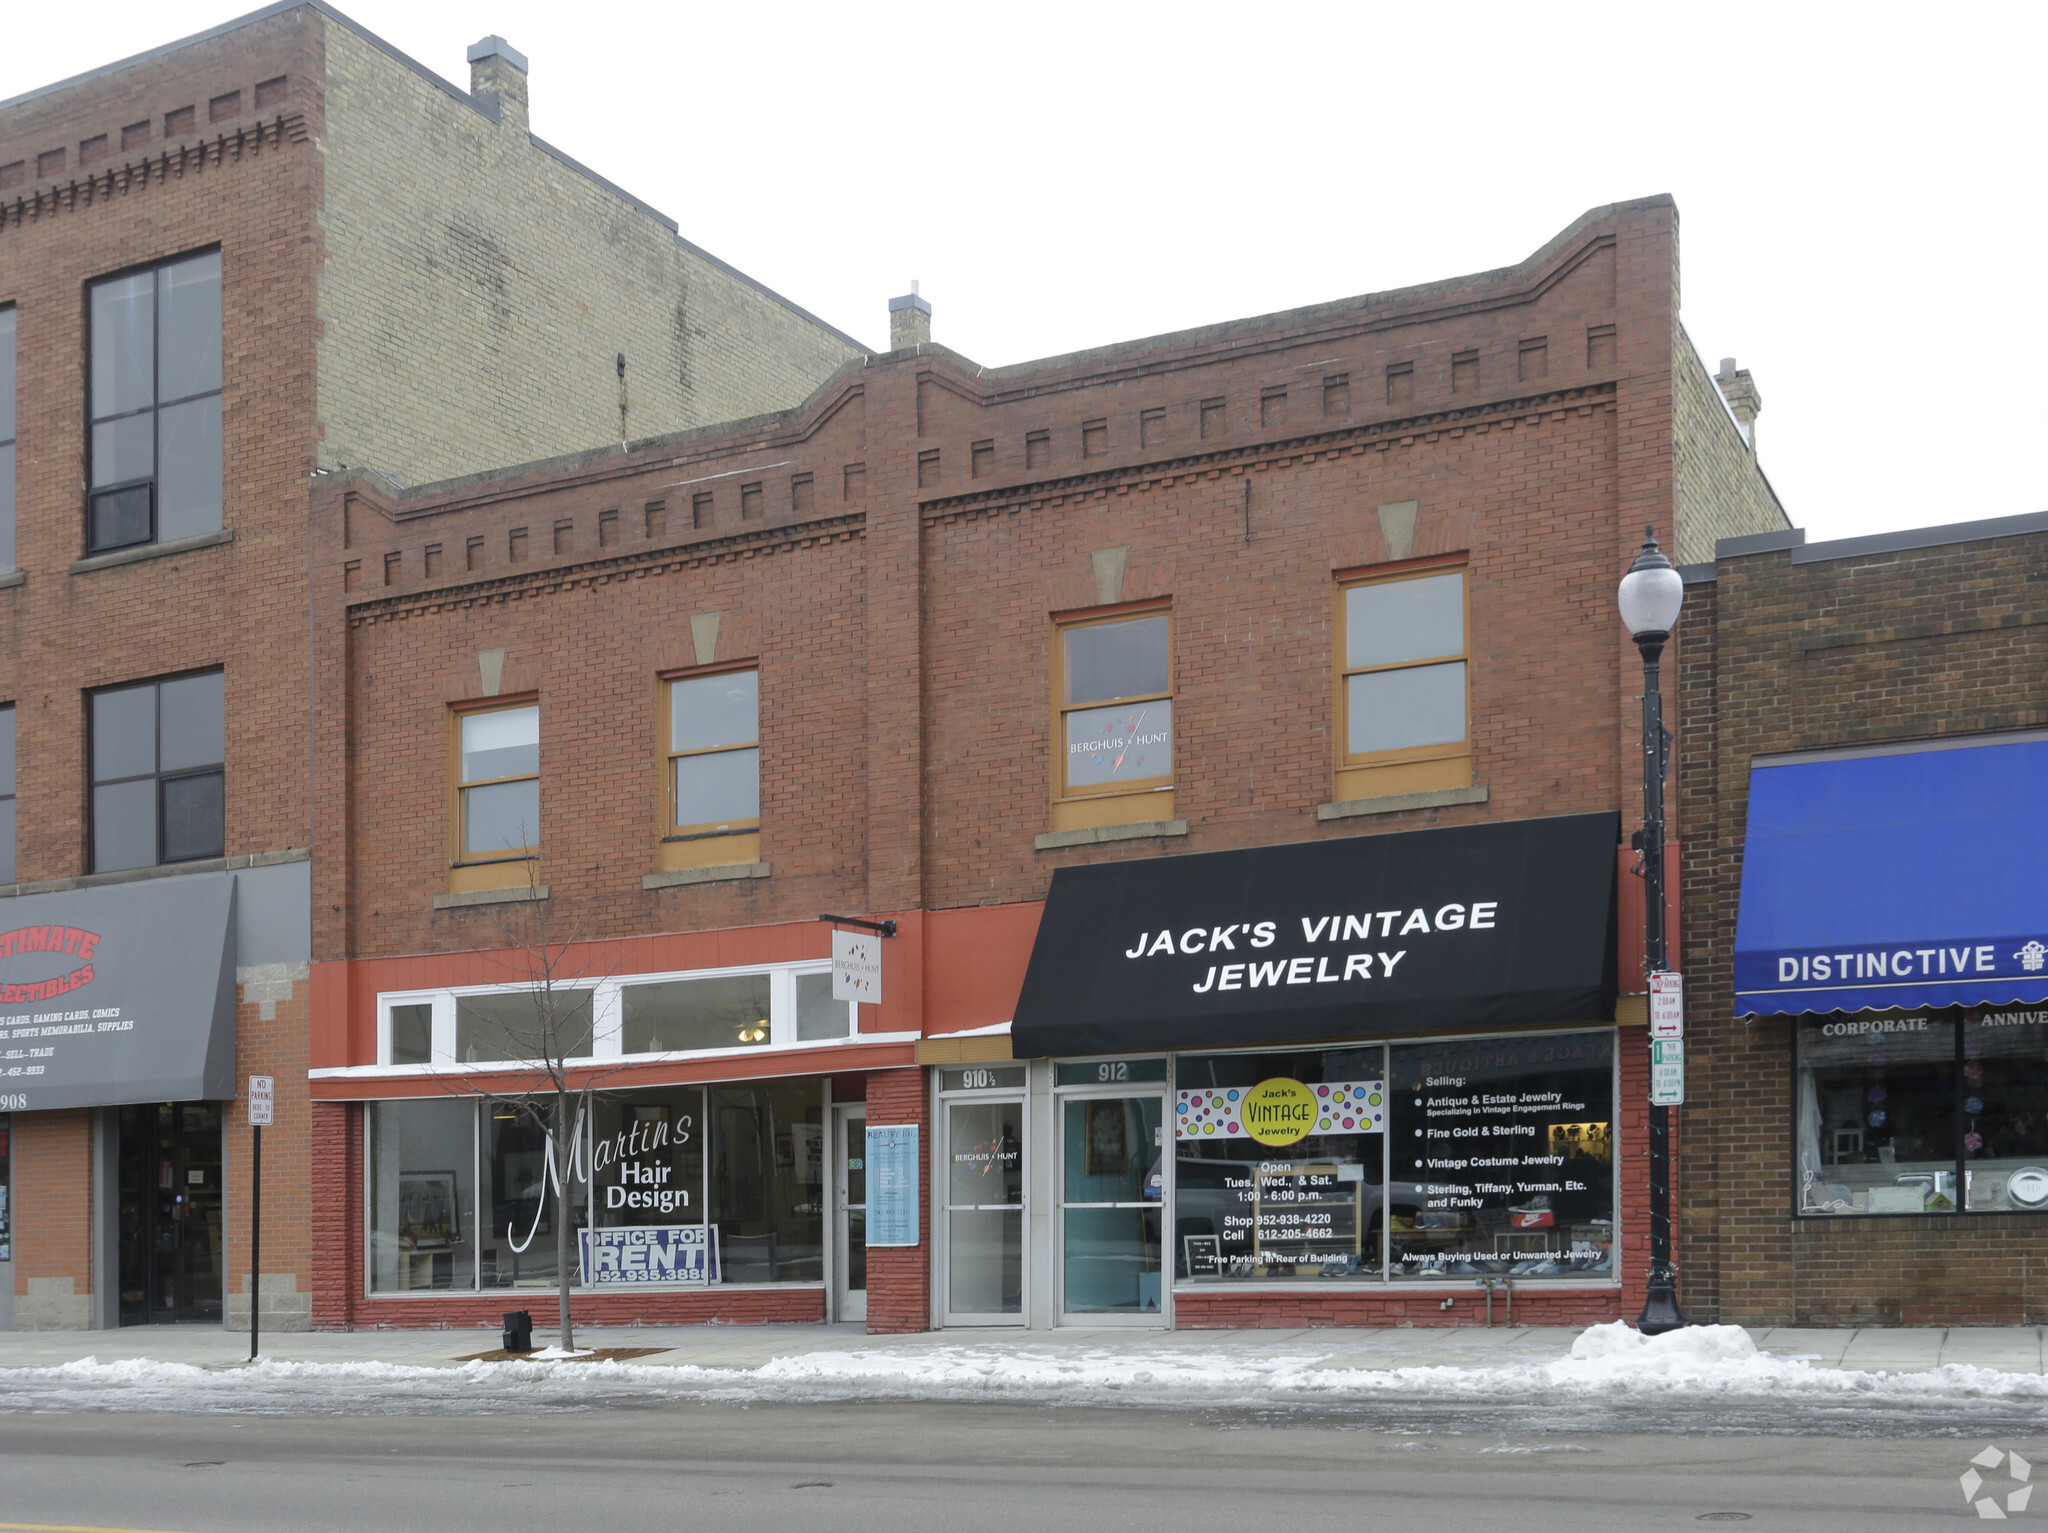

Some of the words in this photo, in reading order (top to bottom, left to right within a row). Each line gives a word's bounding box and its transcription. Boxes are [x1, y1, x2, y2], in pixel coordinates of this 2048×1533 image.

[1070, 737, 1124, 754] BERGHUIS
[1136, 732, 1168, 746] HUNT
[1125, 921, 1277, 959] JACK'S
[1301, 901, 1498, 943] VINTAGE
[0, 925, 101, 961] TIMATE
[834, 960, 860, 972] BERGHUIS
[864, 965, 879, 974] HUNT
[1192, 950, 1407, 993] JEWELRY
[1778, 945, 1996, 982] DISTINCTIVE
[33, 1012, 63, 1024] GAMING
[92, 1007, 120, 1018] COMICS
[12, 1027, 39, 1038] SPORTS
[97, 1020, 134, 1032] SUPPLIES
[1822, 1018, 1928, 1036] CORPORATE
[1656, 1044, 1661, 1061] 1
[963, 1069, 987, 1089] 910
[1098, 1062, 1127, 1081] 912
[257, 1080, 266, 1089] NO
[1426, 1076, 1466, 1088] Selling:
[1, 1093, 27, 1110] 908
[251, 1091, 272, 1101] PARKING
[1262, 1089, 1297, 1098] Jack's
[1426, 1097, 1469, 1108] Antique
[1471, 1095, 1480, 1105] &
[1482, 1093, 1517, 1104] Estate
[1519, 1092, 1562, 1104] Jewelry
[1248, 1102, 1310, 1123] VINTAGE
[1426, 1107, 1472, 1117] Specializing
[1482, 1104, 1511, 1115] Vintage
[1512, 1103, 1561, 1113] Engagement
[1562, 1102, 1586, 1111] Rings
[1258, 1126, 1301, 1137] Jewelry
[1427, 1128, 1451, 1139] Fine
[1452, 1126, 1479, 1138] Gold
[1481, 1126, 1490, 1136] &
[1492, 1124, 1536, 1137] Sterling
[955, 1153, 989, 1162] BERGHUIS
[997, 1152, 1018, 1160] HUNT
[1427, 1158, 1468, 1170] Vintage
[1470, 1156, 1519, 1167] Costume
[1521, 1155, 1564, 1167] Jewelry
[621, 1159, 672, 1185] Hair
[1261, 1162, 1291, 1174] Open
[508, 1108, 692, 1253] Martins
[1260, 1176, 1292, 1188] Wed.,
[1298, 1176, 1307, 1186] &
[1310, 1175, 1332, 1186] Sat.
[1427, 1183, 1472, 1196] Sterling,
[1474, 1182, 1514, 1195] Tiffany,
[1516, 1181, 1562, 1193] Yurman,
[1565, 1180, 1587, 1191] Etc.
[607, 1183, 690, 1214] Design
[1237, 1191, 1261, 1202] 1:00
[1270, 1190, 1295, 1201] 6:00
[1297, 1191, 1322, 1202] p.m.
[1427, 1198, 1447, 1208] and
[1450, 1196, 1484, 1209] Funky
[1224, 1216, 1254, 1228] Shop
[1256, 1213, 1332, 1226] 952-938-4220
[586, 1230, 659, 1246] OFFICE
[1223, 1229, 1245, 1240] Cell
[1257, 1227, 1333, 1240] 612-205-4662
[594, 1243, 705, 1271] RENT
[1208, 1254, 1228, 1264] Free
[1230, 1254, 1263, 1265] Parking
[1276, 1253, 1299, 1263] Rear
[1300, 1253, 1309, 1263] of
[1310, 1253, 1349, 1264] Building
[1401, 1252, 1436, 1263] Always
[1438, 1251, 1472, 1262] Buying
[1474, 1250, 1499, 1261] Used
[1500, 1251, 1511, 1260] or
[1512, 1250, 1562, 1260] Unwanted
[1563, 1248, 1602, 1261] Jewelry
